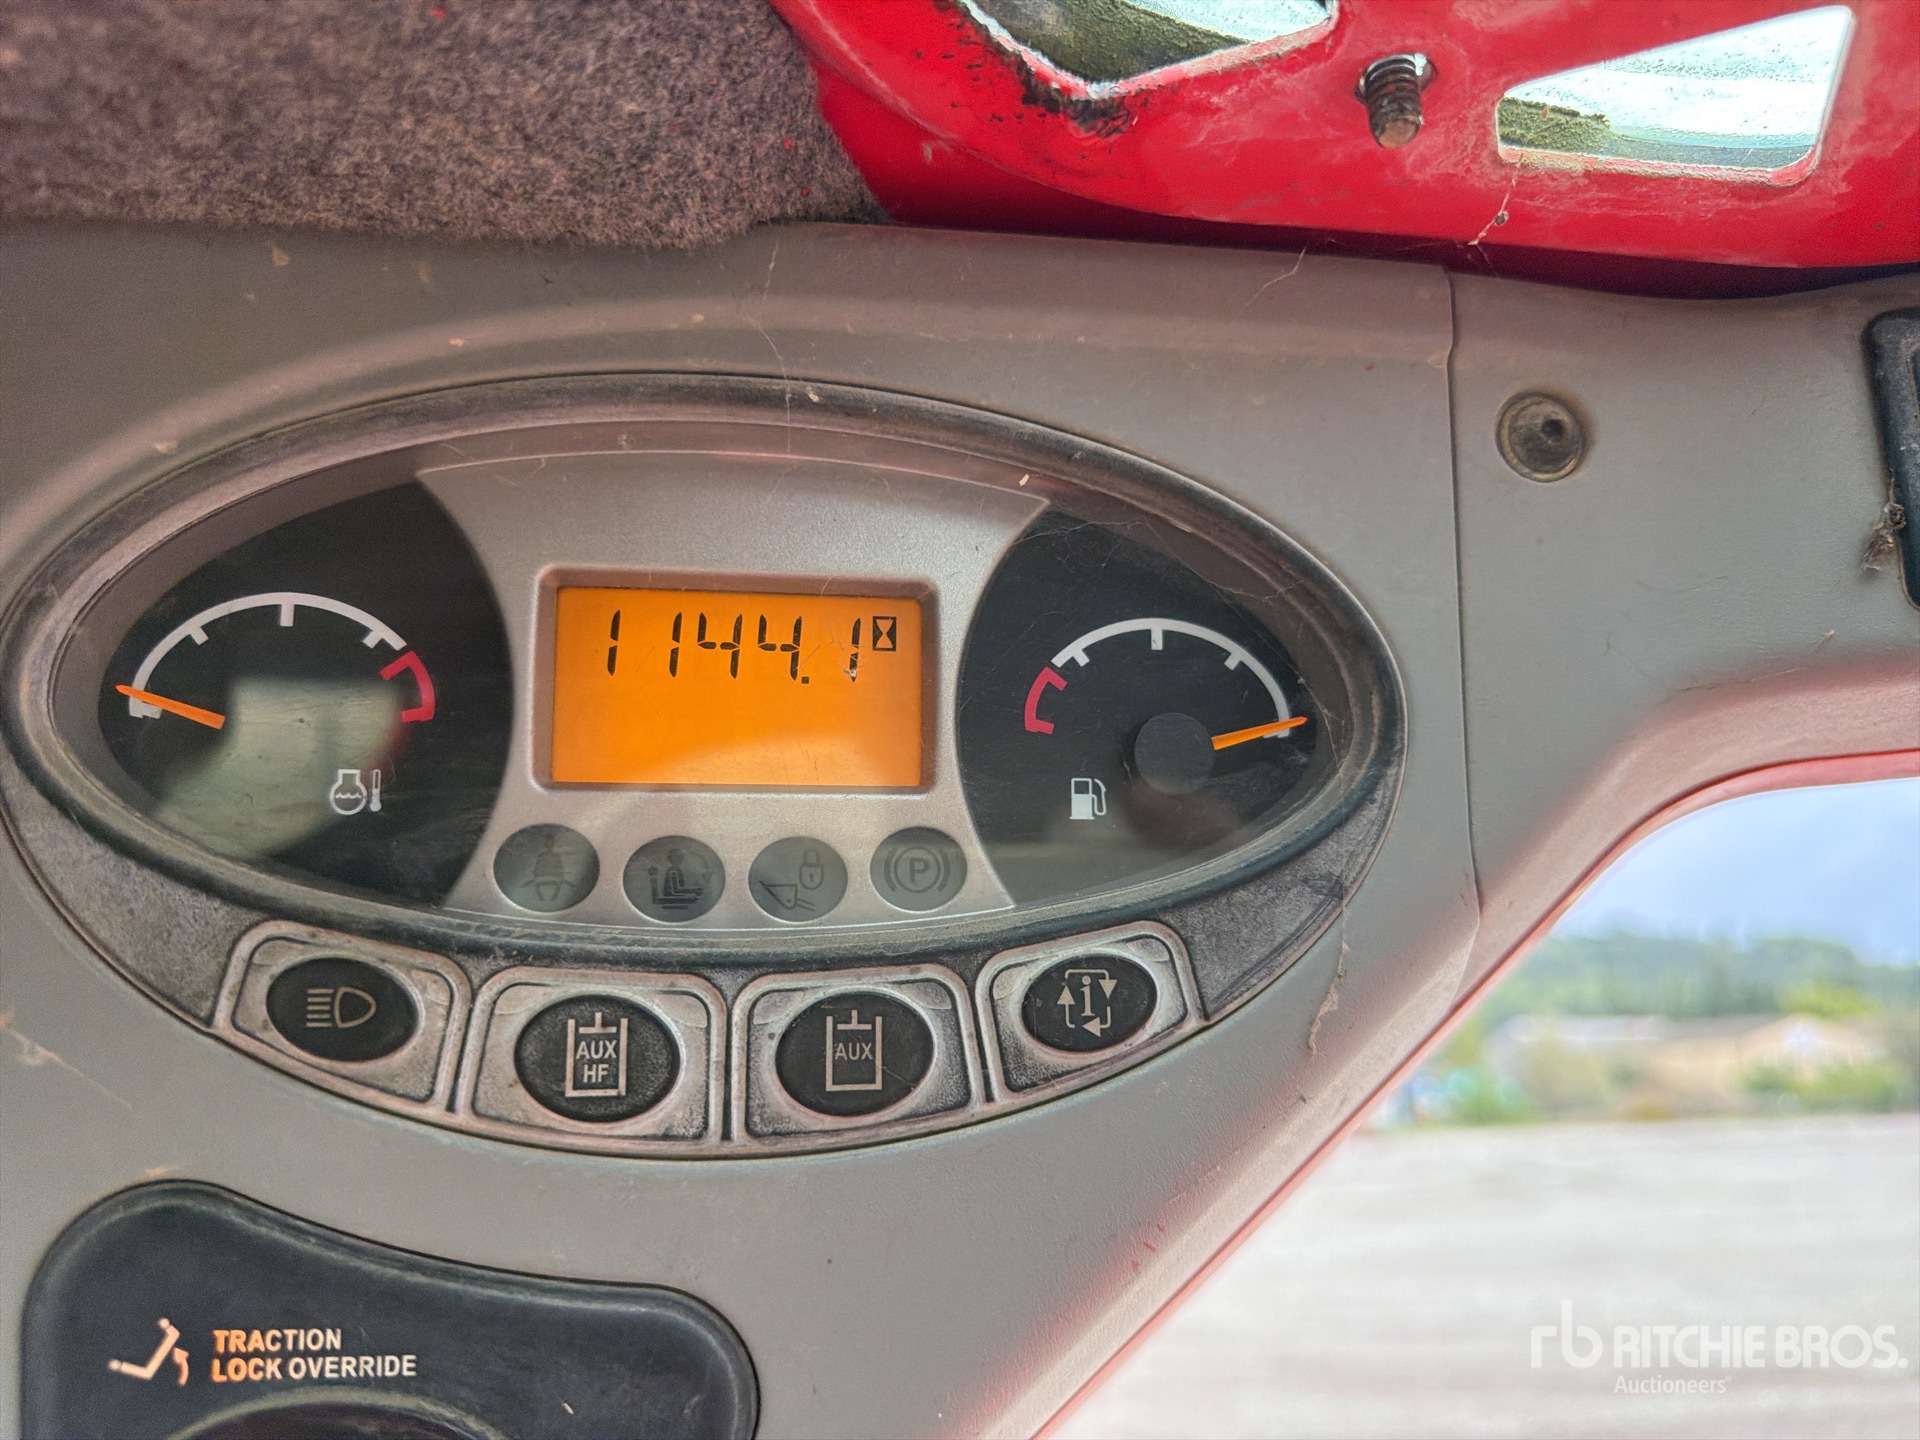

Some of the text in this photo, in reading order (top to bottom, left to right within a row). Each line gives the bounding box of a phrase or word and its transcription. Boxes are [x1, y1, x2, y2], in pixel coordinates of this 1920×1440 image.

[607, 609, 861, 685] 1144.1
[576, 1039, 617, 1060] AUX
[834, 1042, 874, 1061] AUX
[583, 1064, 609, 1084] HF
[213, 1328, 343, 1353] TRACTION
[211, 1354, 418, 1382] LOCK OVERRIDE
